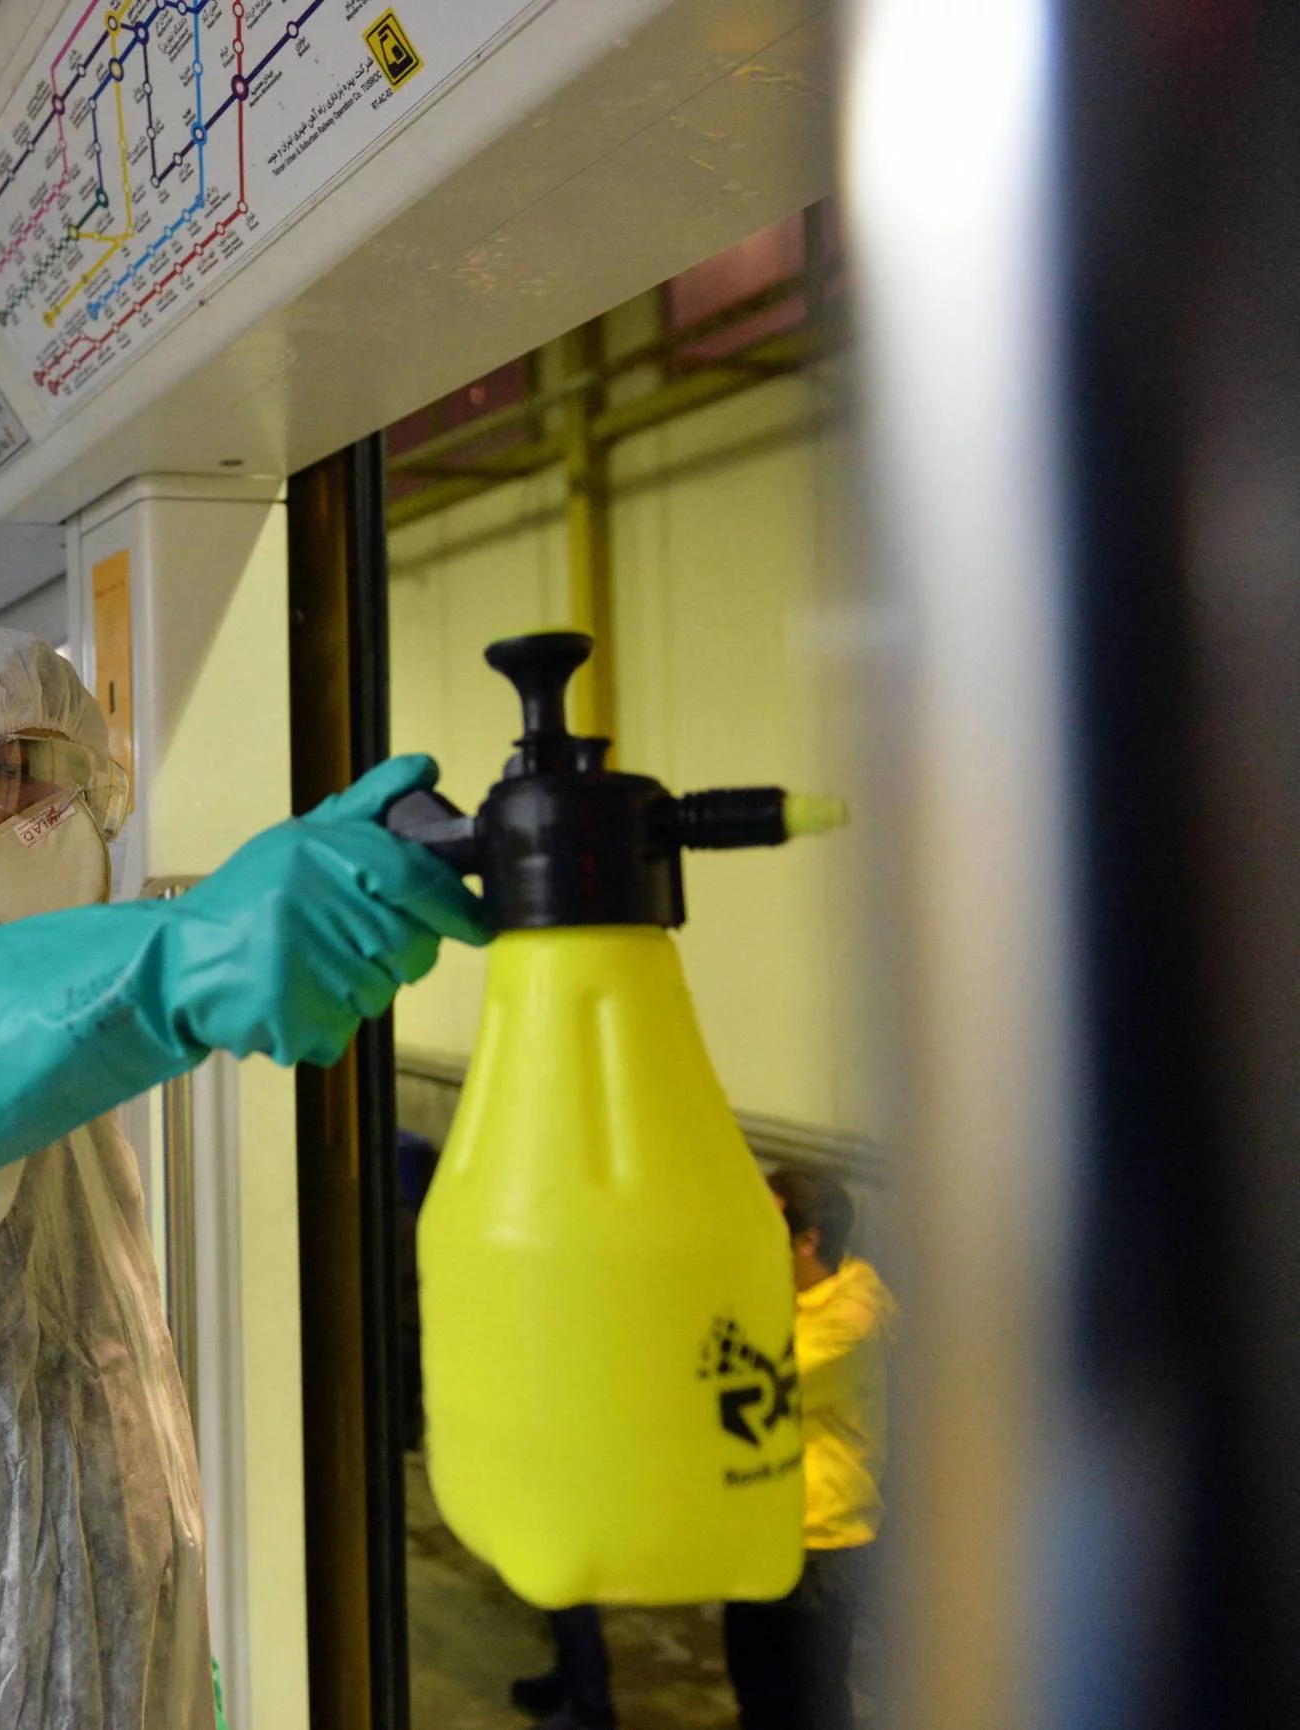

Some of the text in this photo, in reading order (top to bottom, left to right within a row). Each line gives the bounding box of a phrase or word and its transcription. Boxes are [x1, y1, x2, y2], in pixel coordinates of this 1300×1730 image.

[354, 56, 374, 78] شرکت
[342, 77, 356, 90] بهره
[326, 87, 345, 109] برداری
[307, 108, 319, 128] آهن
[317, 117, 335, 134] Railway
[333, 98, 354, 120] Operation
[293, 122, 308, 141] شهری
[281, 135, 294, 152] تهران
